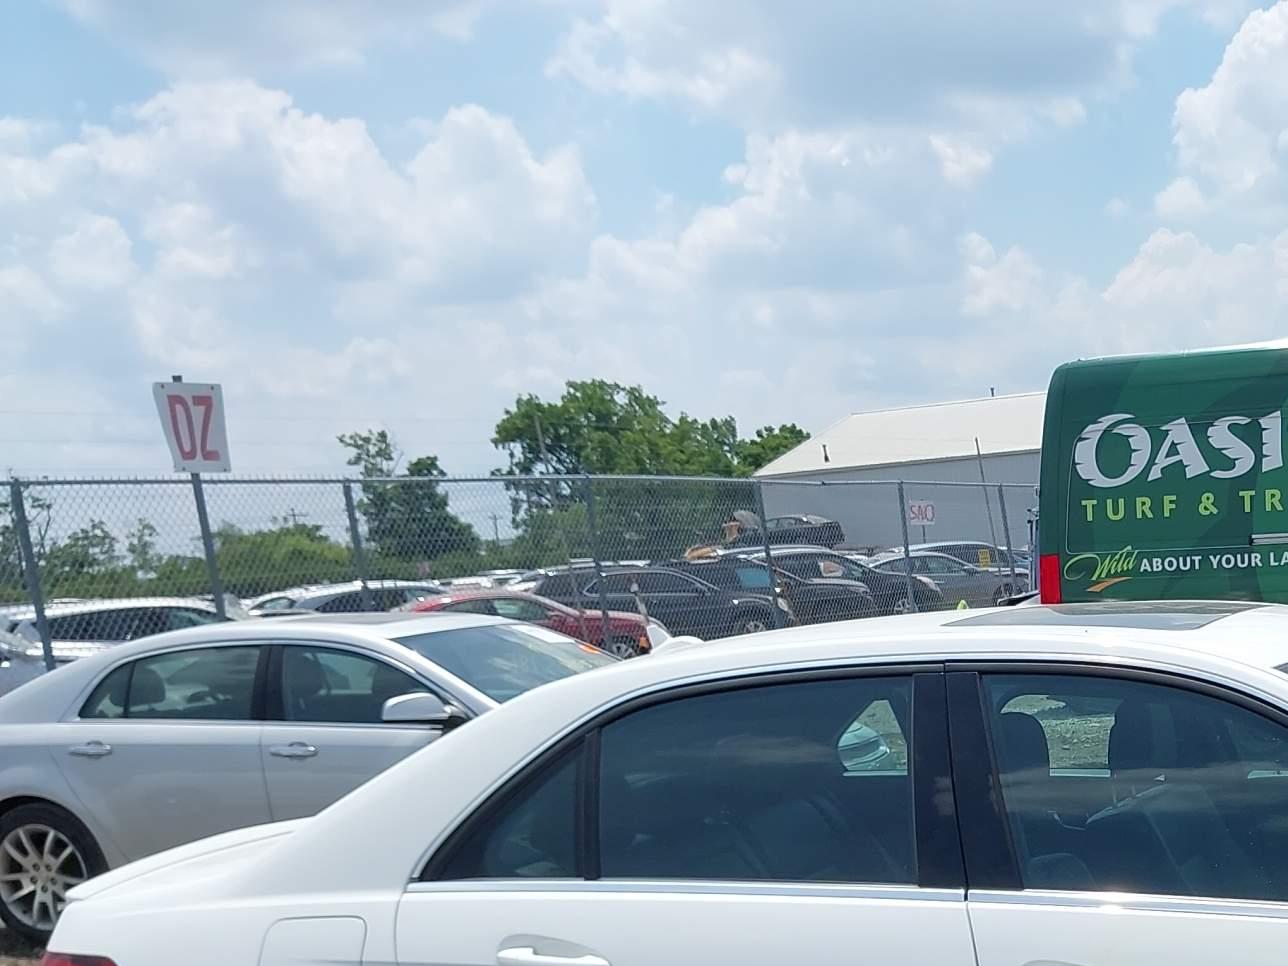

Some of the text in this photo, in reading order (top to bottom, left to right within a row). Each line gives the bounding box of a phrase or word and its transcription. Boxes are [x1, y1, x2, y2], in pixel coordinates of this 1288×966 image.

[166, 393, 221, 461] DZ
[1081, 495, 1177, 521] TURF
[1197, 492, 1219, 516] &
[1063, 545, 1139, 581] Wild
[1140, 555, 1202, 573] ABOUT
[1208, 553, 1263, 570] YOUR
